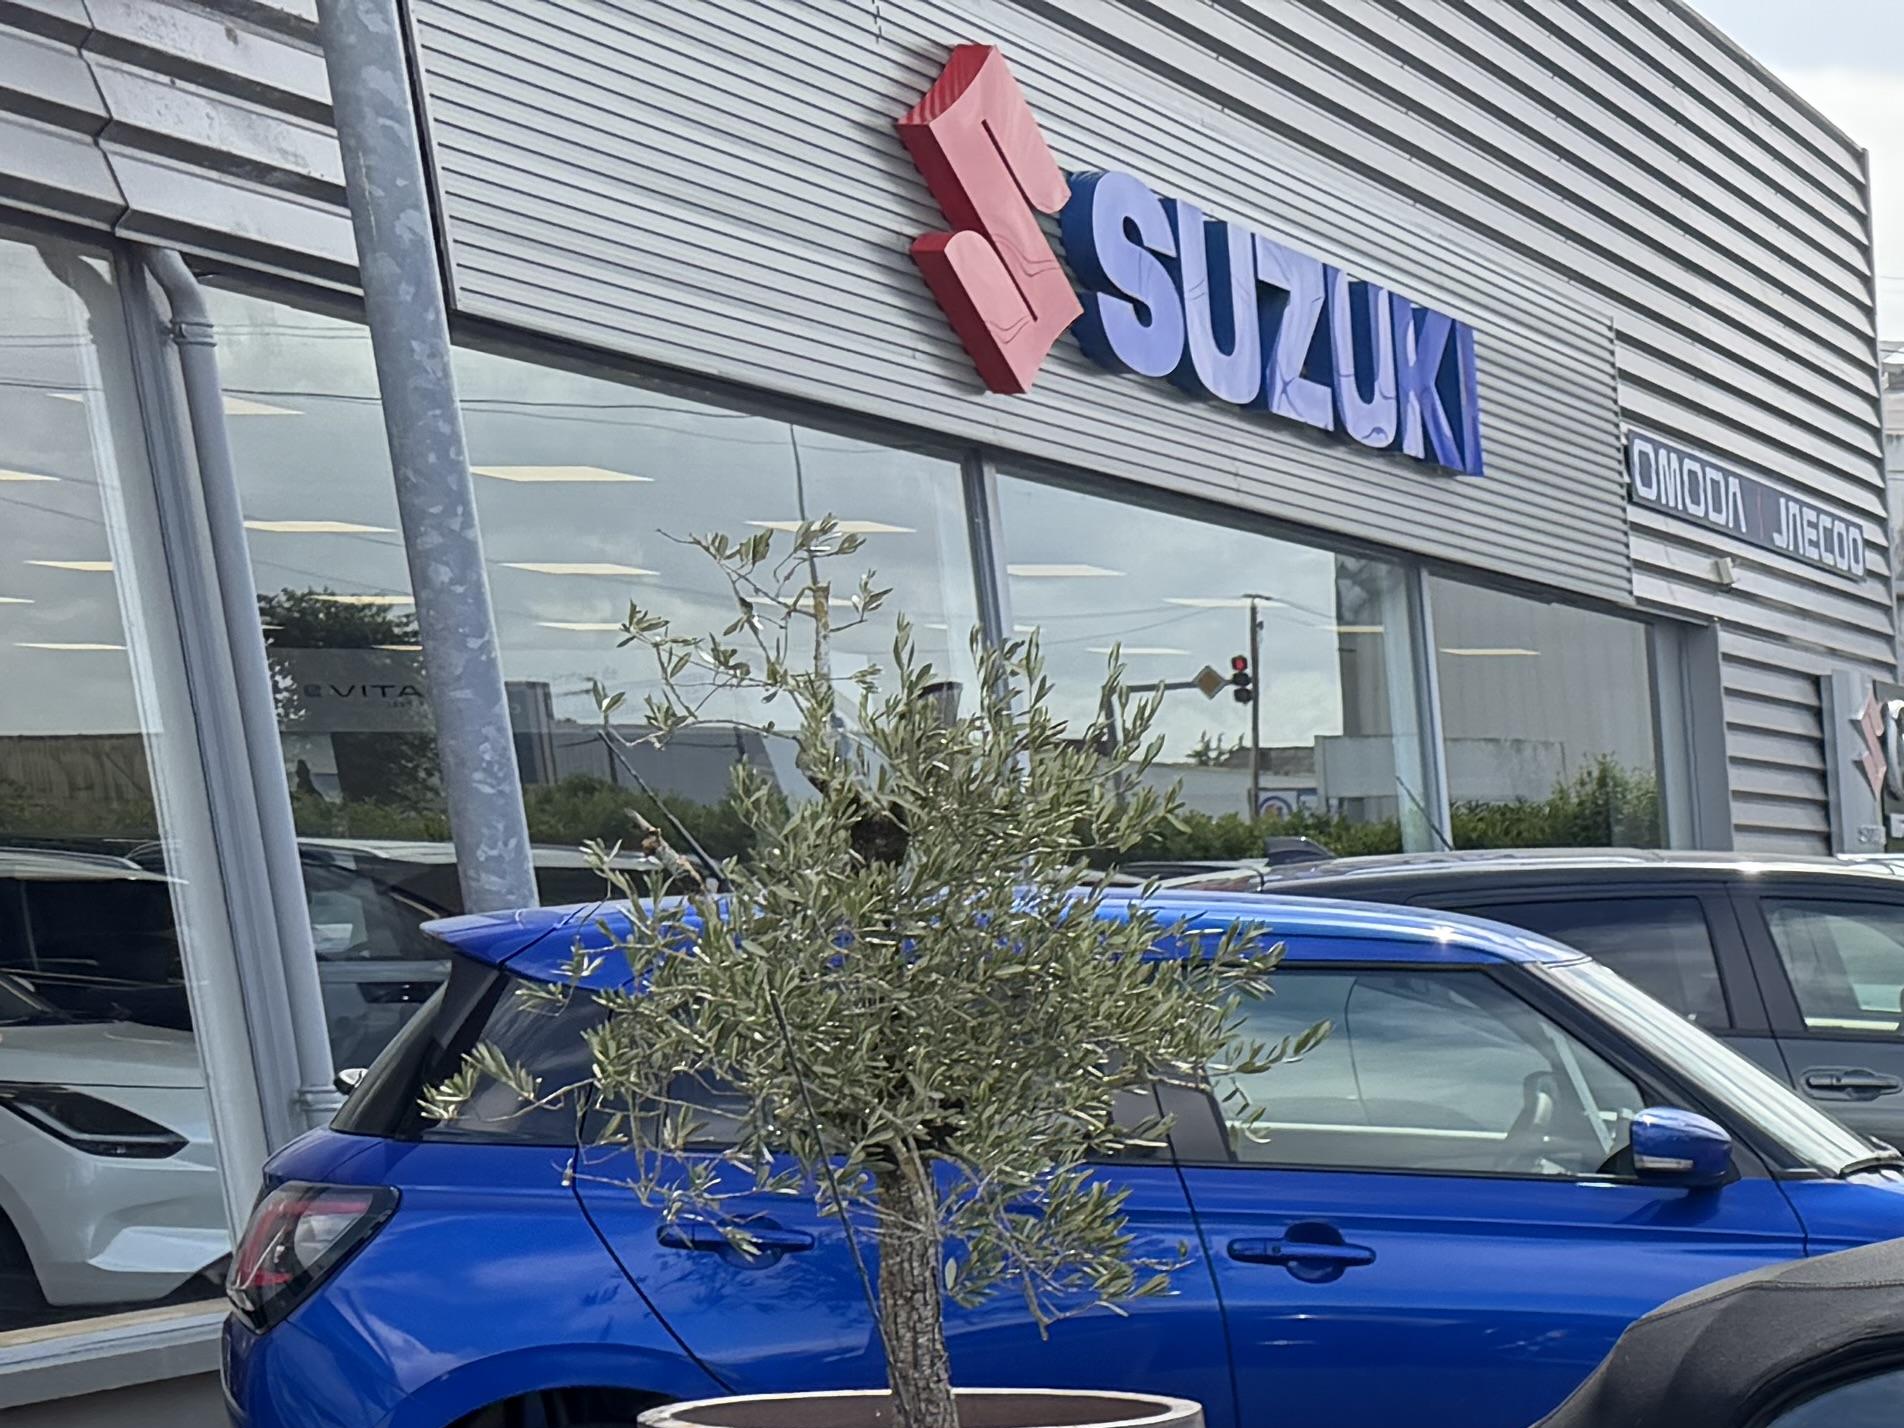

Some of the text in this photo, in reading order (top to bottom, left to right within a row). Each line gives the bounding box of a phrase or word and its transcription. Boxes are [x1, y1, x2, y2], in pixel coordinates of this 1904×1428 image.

[1080, 171, 1484, 477] SUZUKI
[1633, 438, 1864, 577] OMODA JAECOO
[329, 684, 425, 698] VITA
